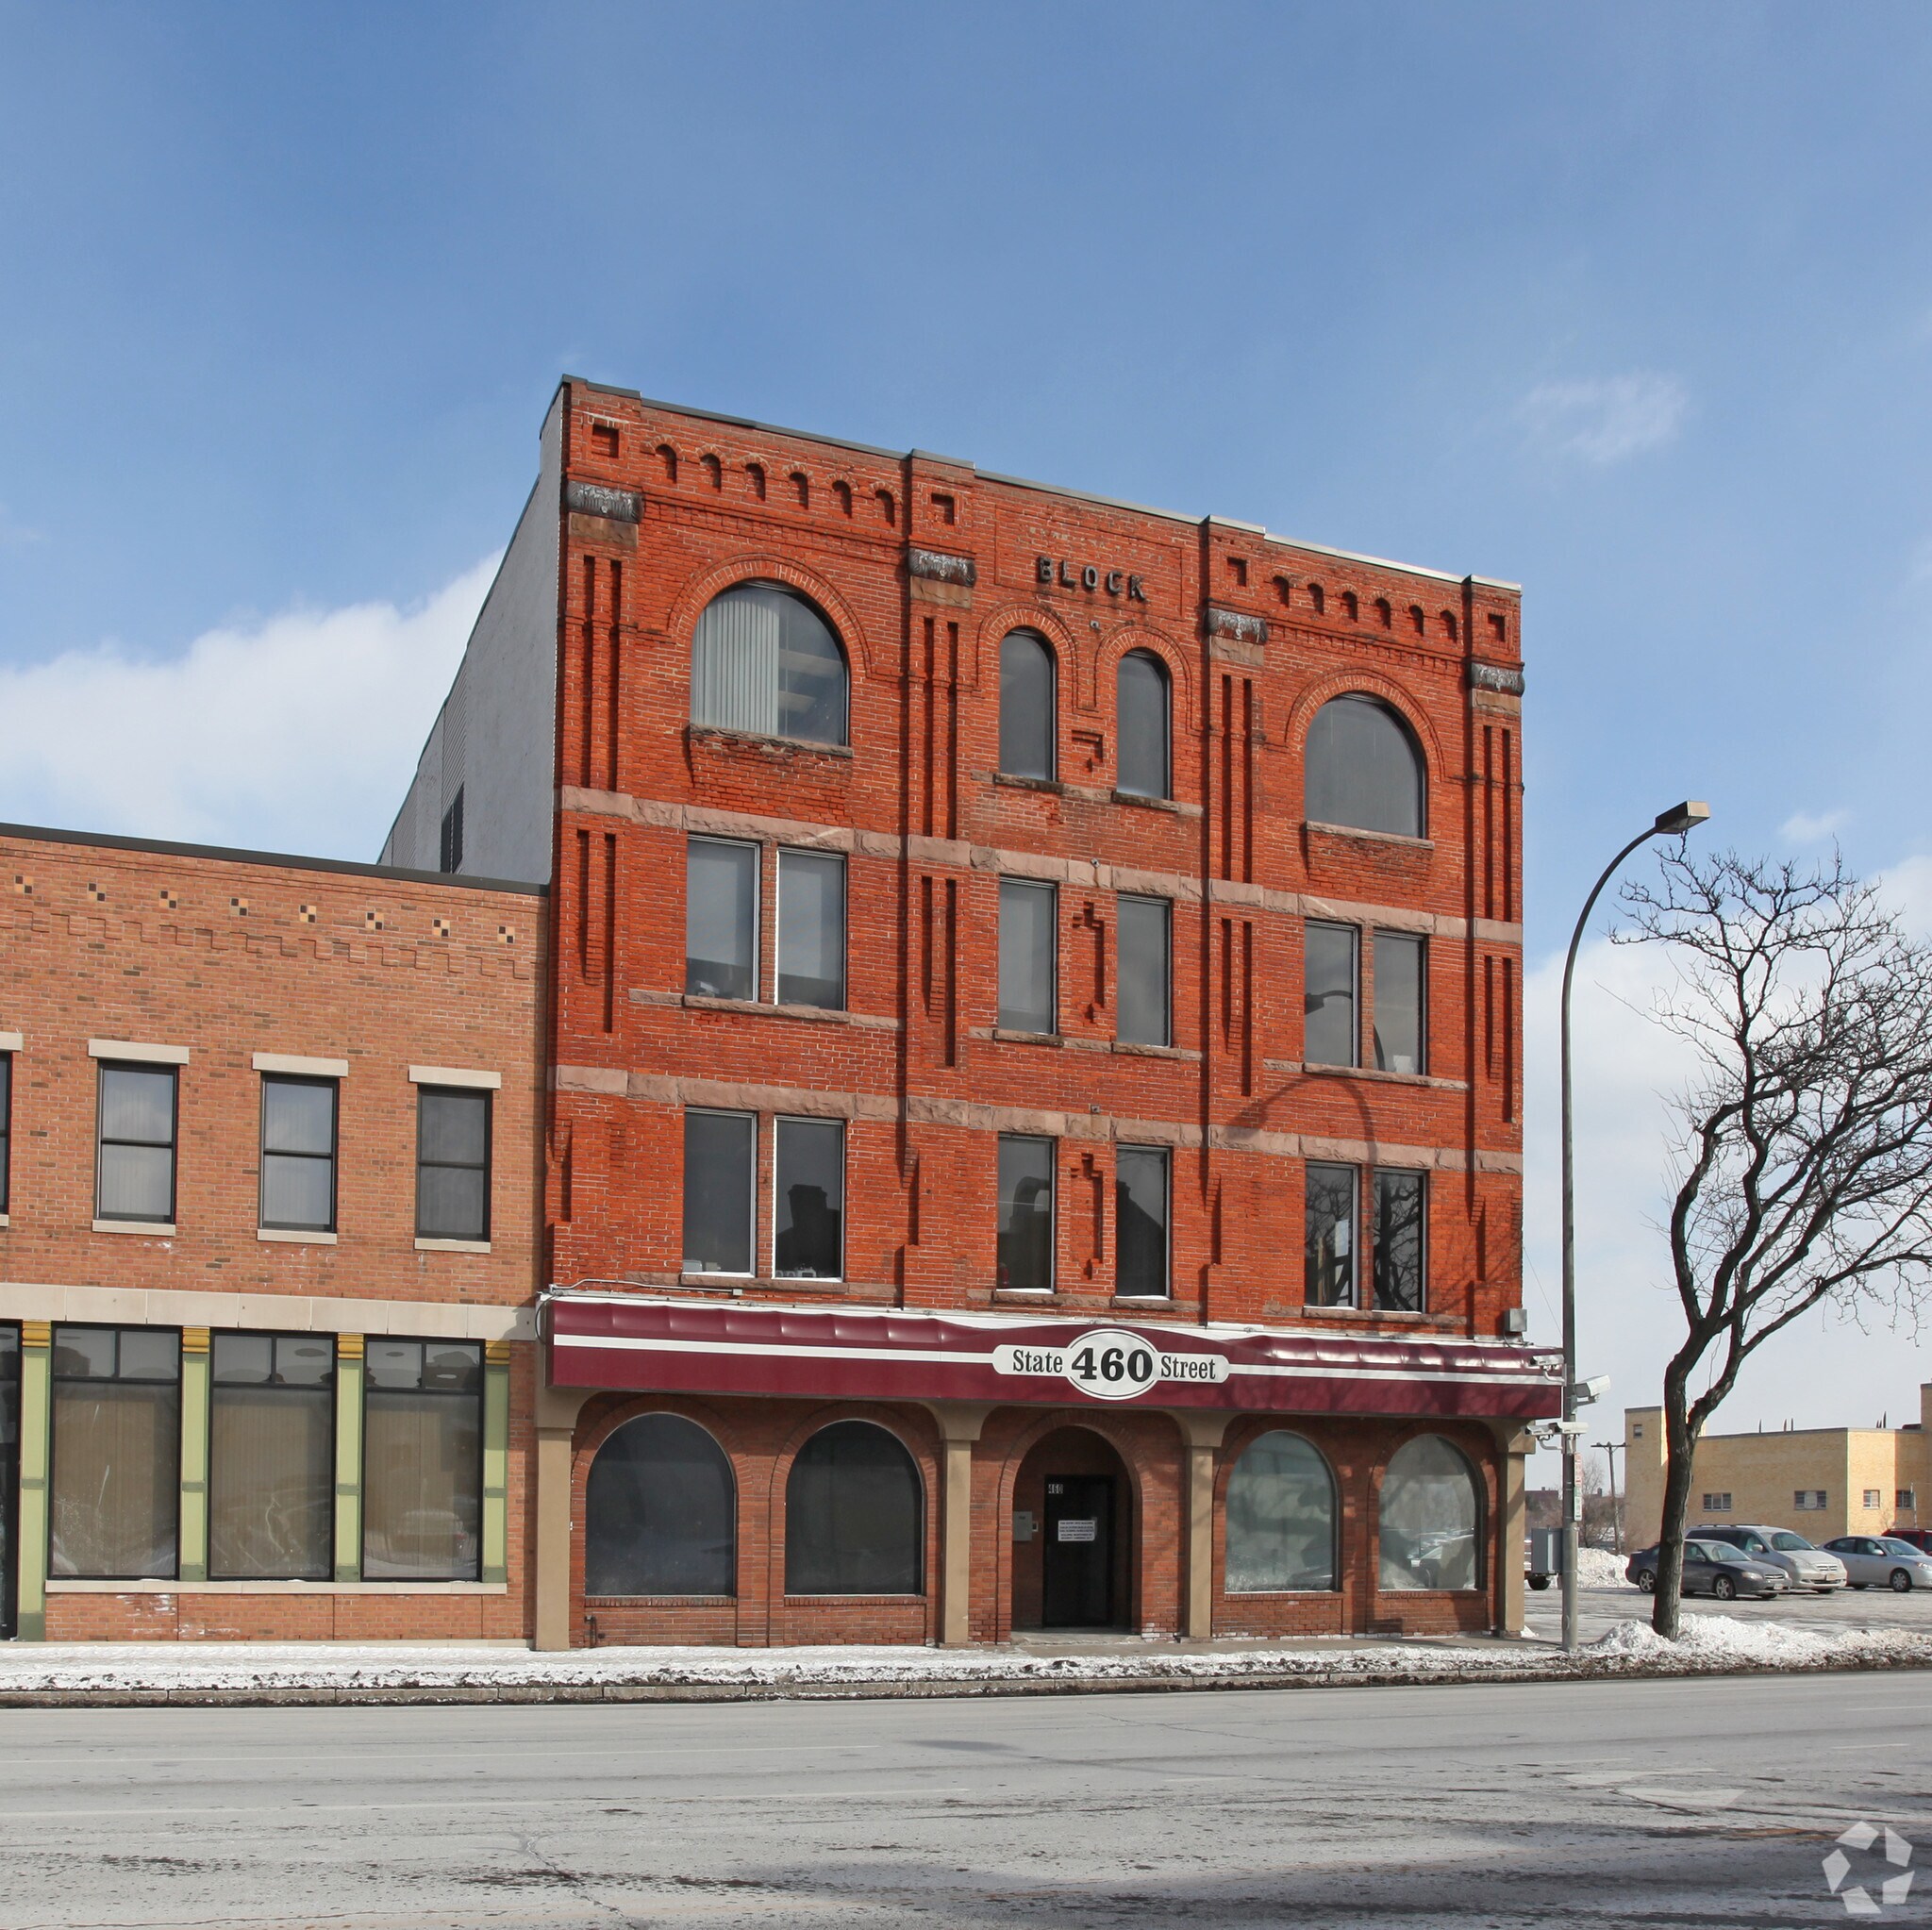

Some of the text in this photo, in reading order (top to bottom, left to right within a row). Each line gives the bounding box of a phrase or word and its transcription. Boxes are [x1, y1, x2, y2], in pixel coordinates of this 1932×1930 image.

[1037, 556, 1146, 602] BLOCK
[1012, 1347, 1216, 1383] State 460 Street
[1048, 1483, 1064, 1494] 460
